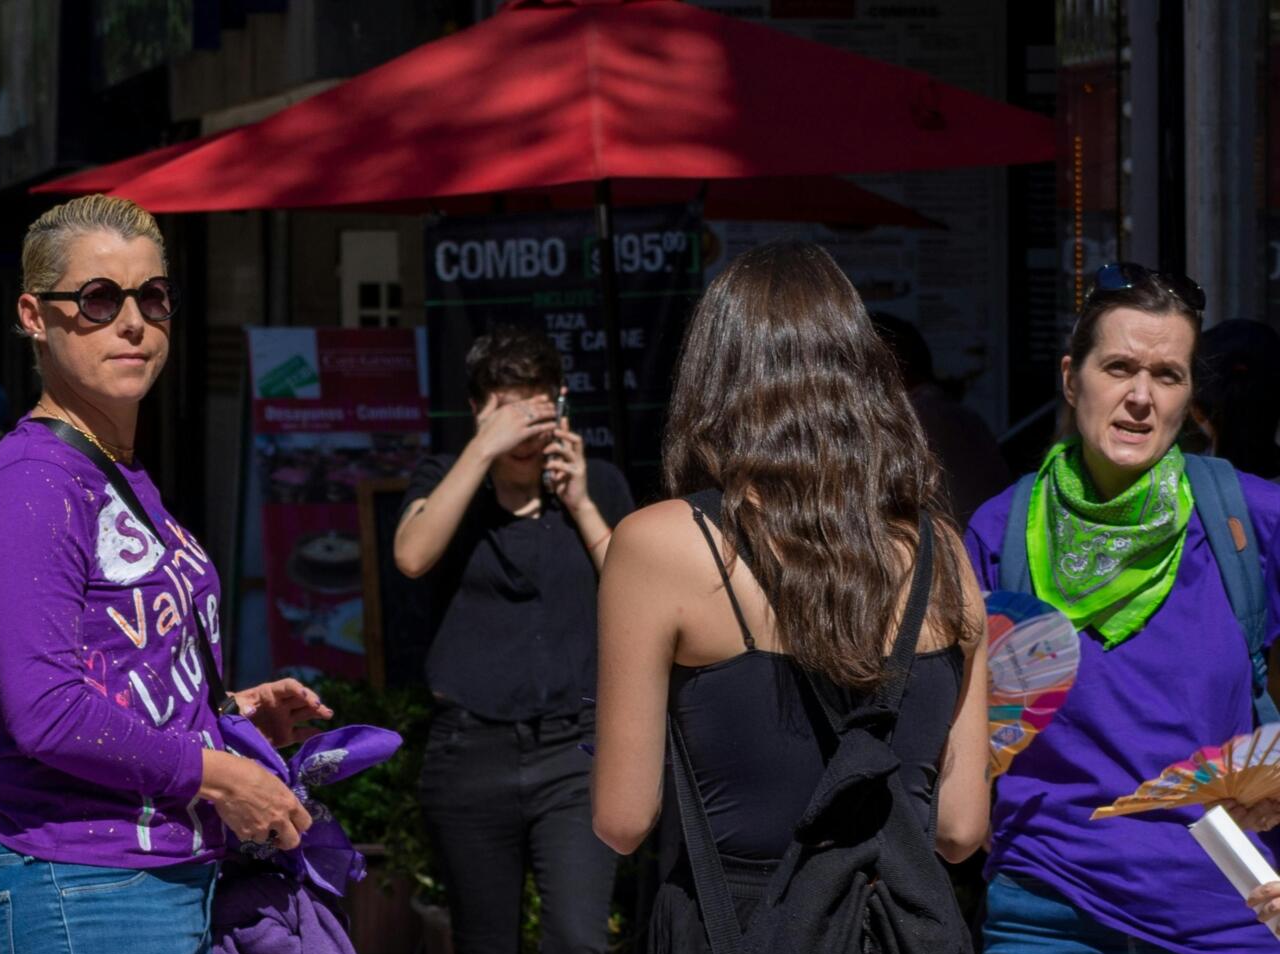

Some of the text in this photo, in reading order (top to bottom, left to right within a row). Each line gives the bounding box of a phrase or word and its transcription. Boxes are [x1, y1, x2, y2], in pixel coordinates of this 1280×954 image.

[434, 237, 567, 281] COMBO
[544, 312, 586, 329] TAZA
[580, 329, 646, 352] CANE
[128, 593, 220, 728] Libe
